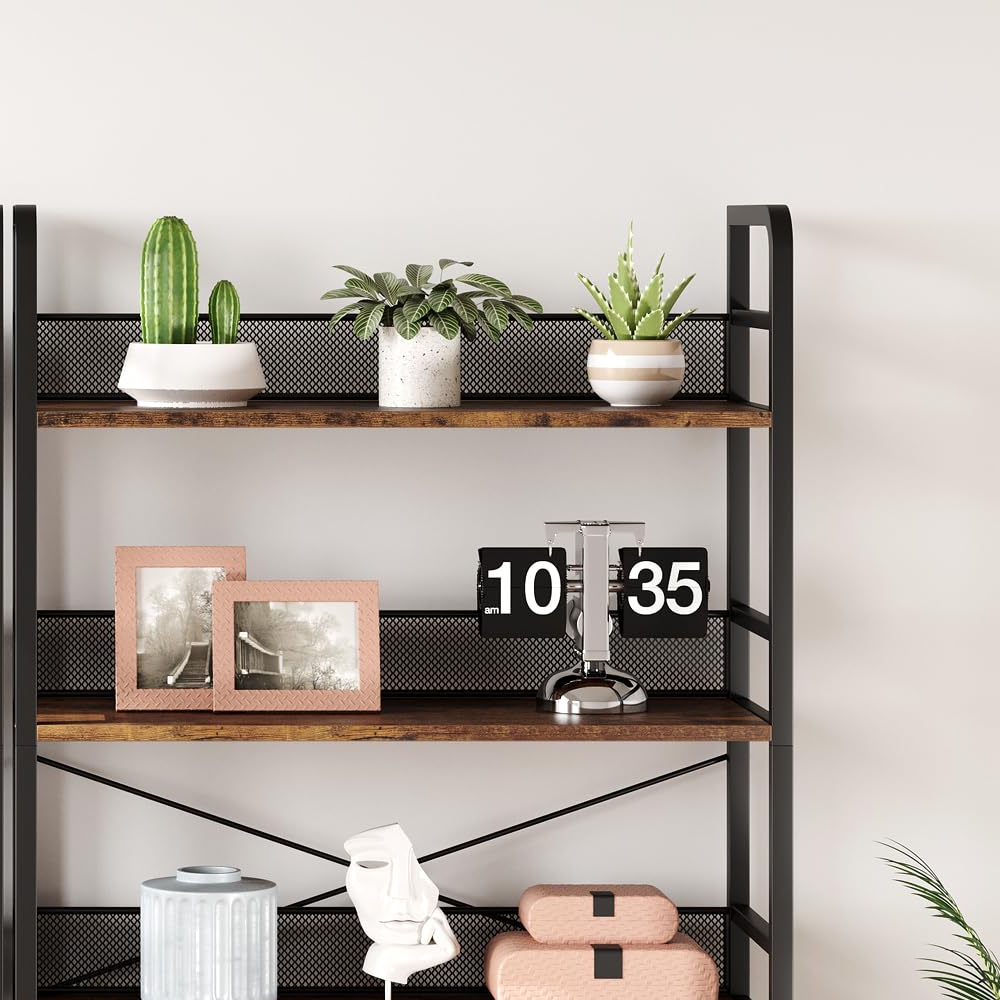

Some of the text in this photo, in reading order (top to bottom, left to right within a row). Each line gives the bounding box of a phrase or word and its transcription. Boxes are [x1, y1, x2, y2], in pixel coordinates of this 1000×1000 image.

[483, 605, 499, 615] am
[486, 561, 561, 615] 10
[628, 561, 702, 615] 35
